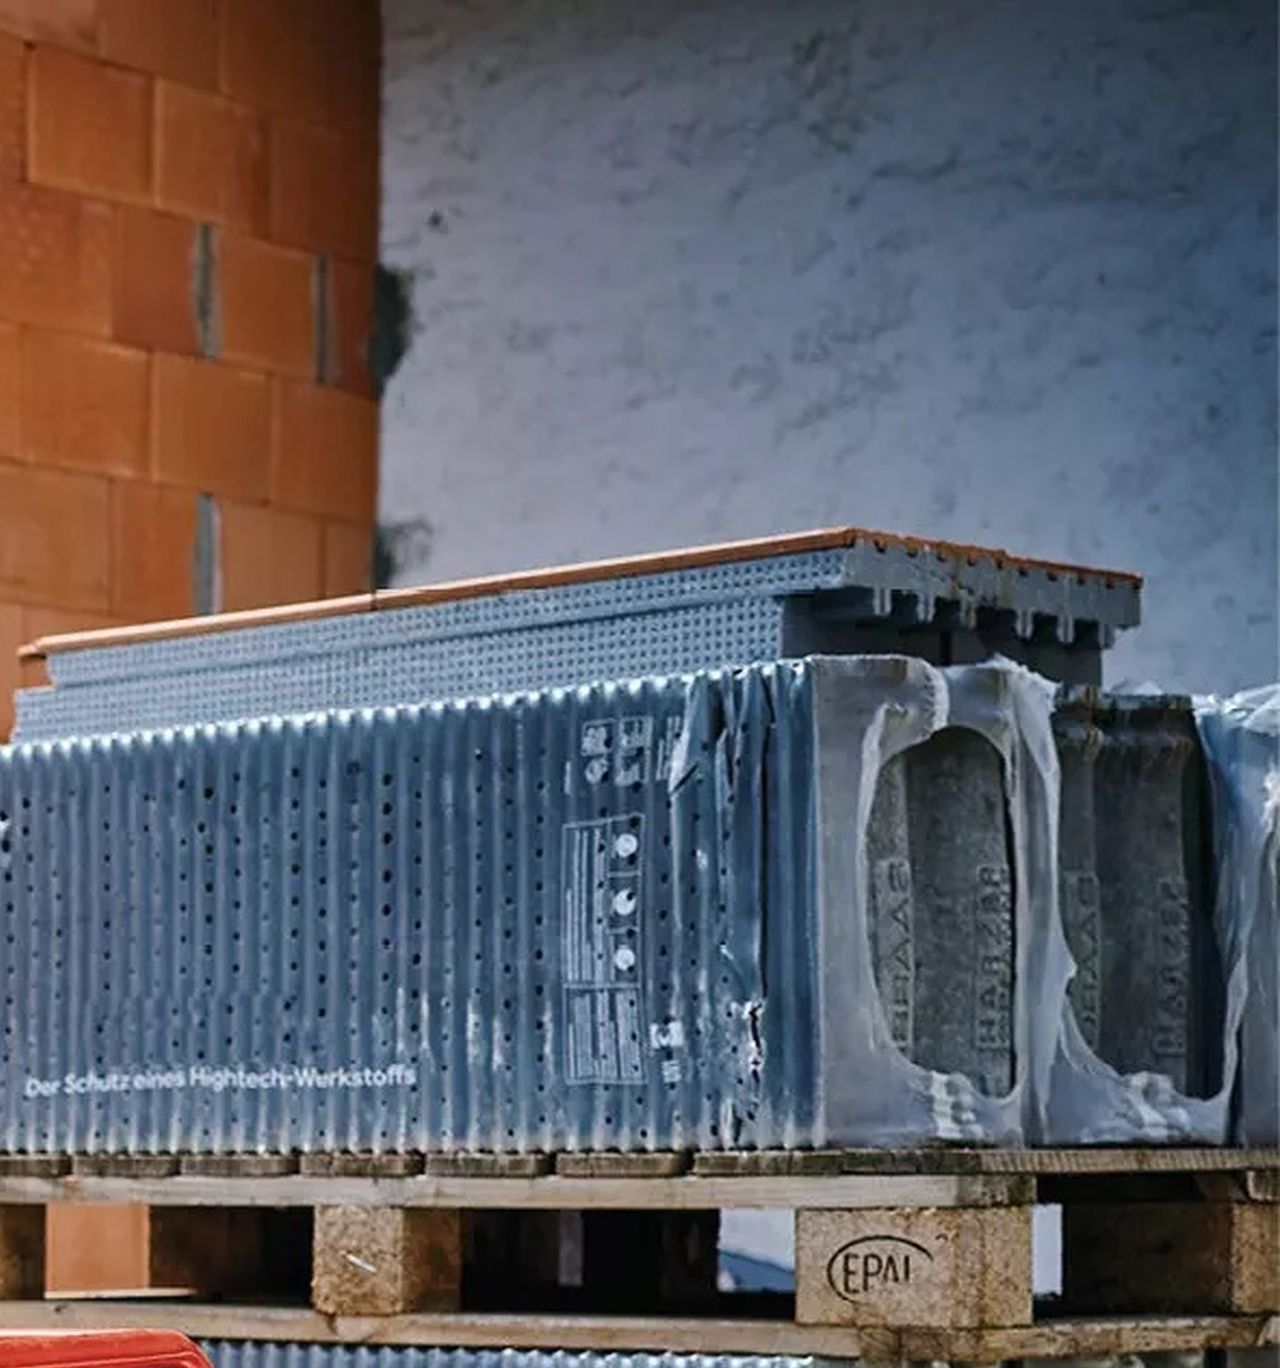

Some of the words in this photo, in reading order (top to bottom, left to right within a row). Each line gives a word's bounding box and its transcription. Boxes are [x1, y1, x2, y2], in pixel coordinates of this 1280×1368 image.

[24, 1077, 61, 1098] Der
[64, 1069, 130, 1095] Schutz
[133, 1069, 186, 1091] eines
